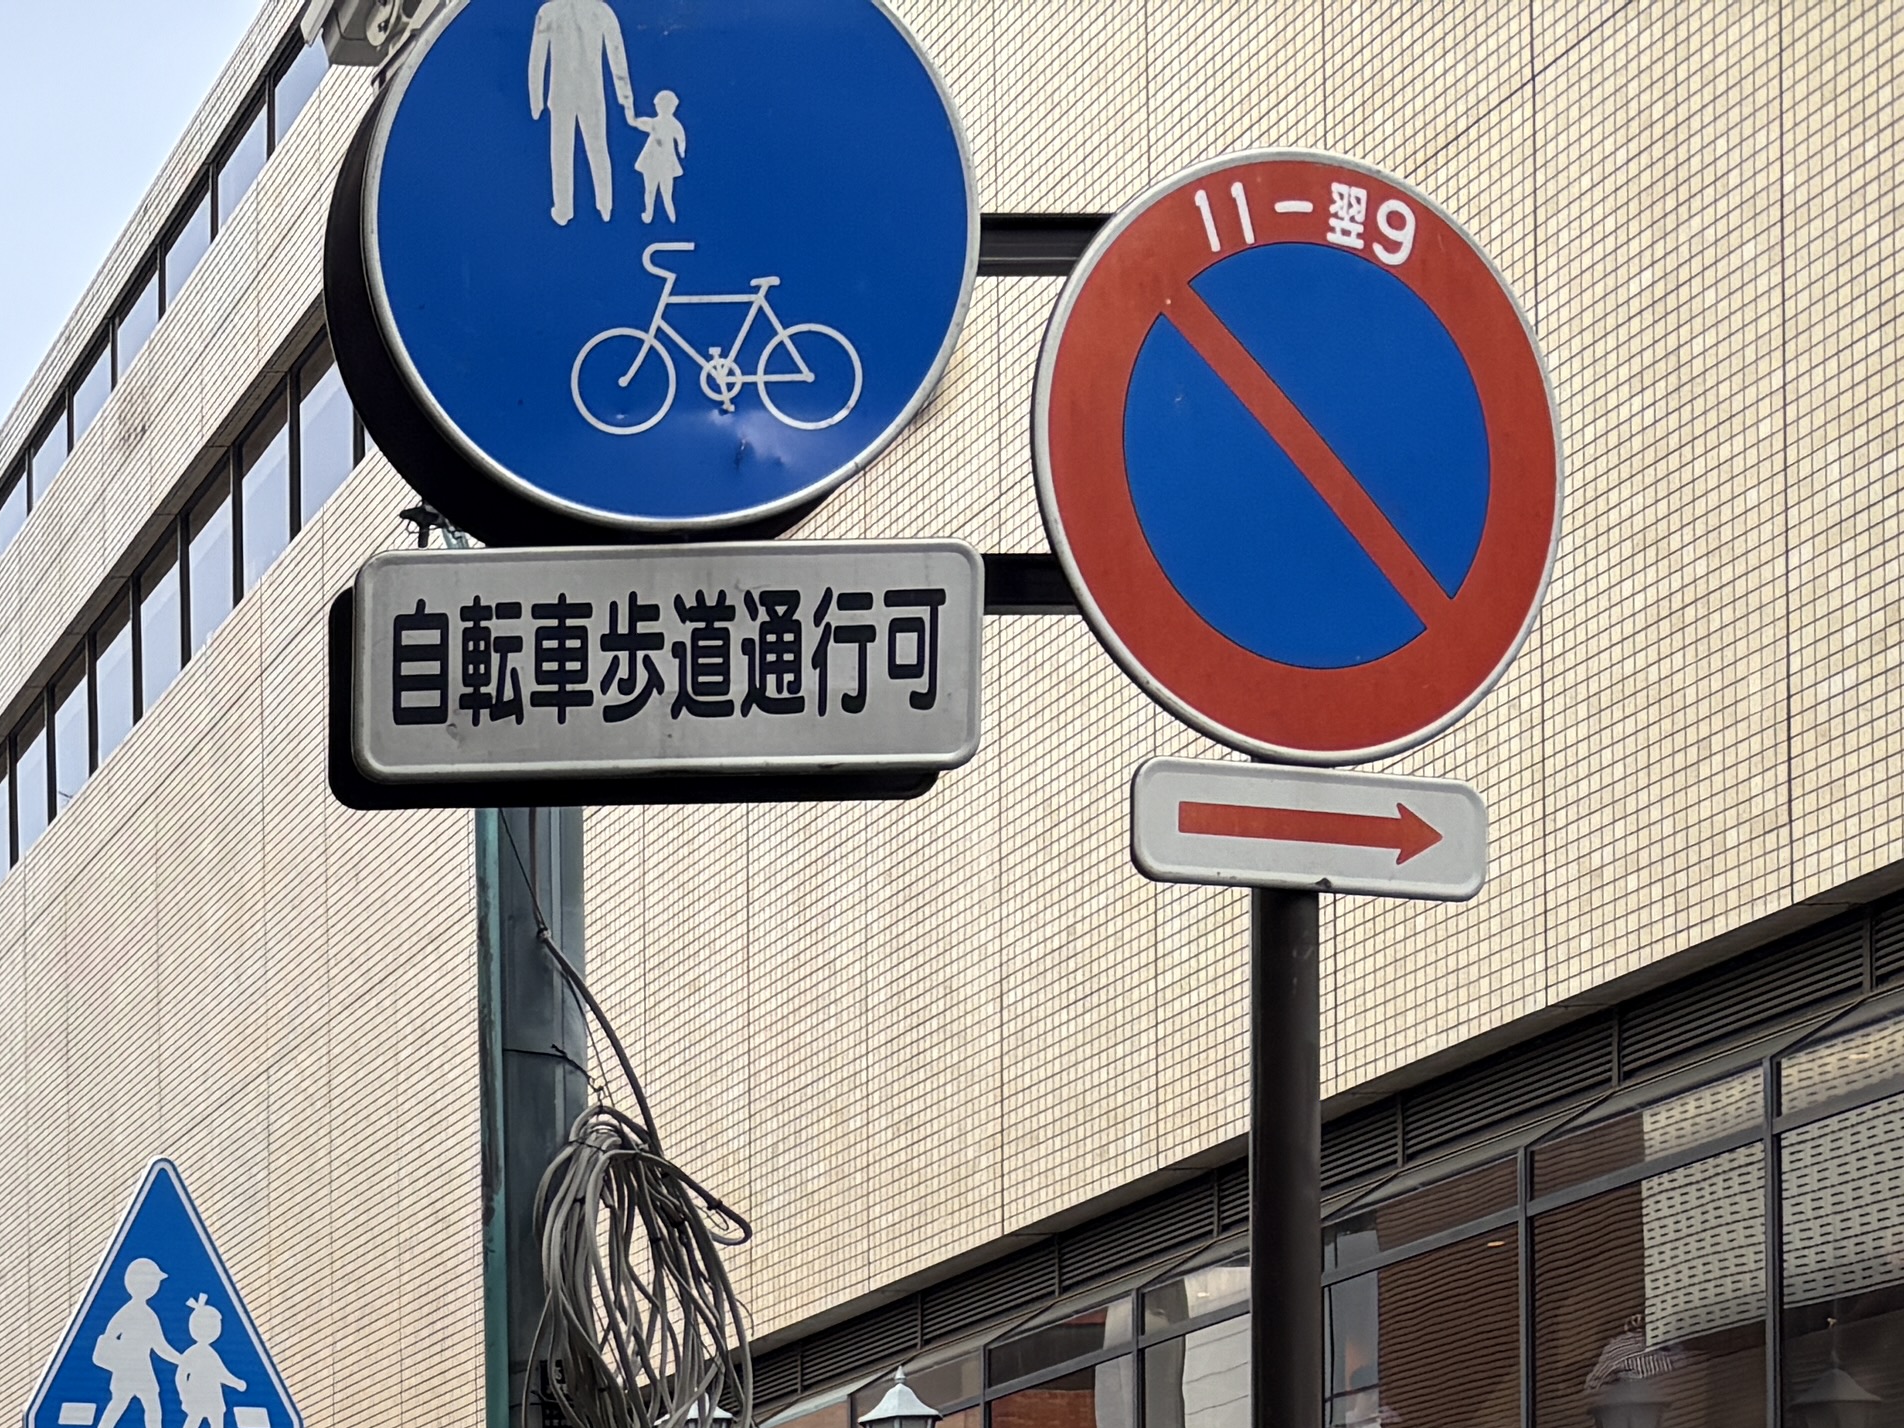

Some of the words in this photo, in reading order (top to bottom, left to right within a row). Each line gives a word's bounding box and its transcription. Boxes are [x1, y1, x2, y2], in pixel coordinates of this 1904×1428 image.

[392, 587, 947, 727] 自転車歩道通行可
